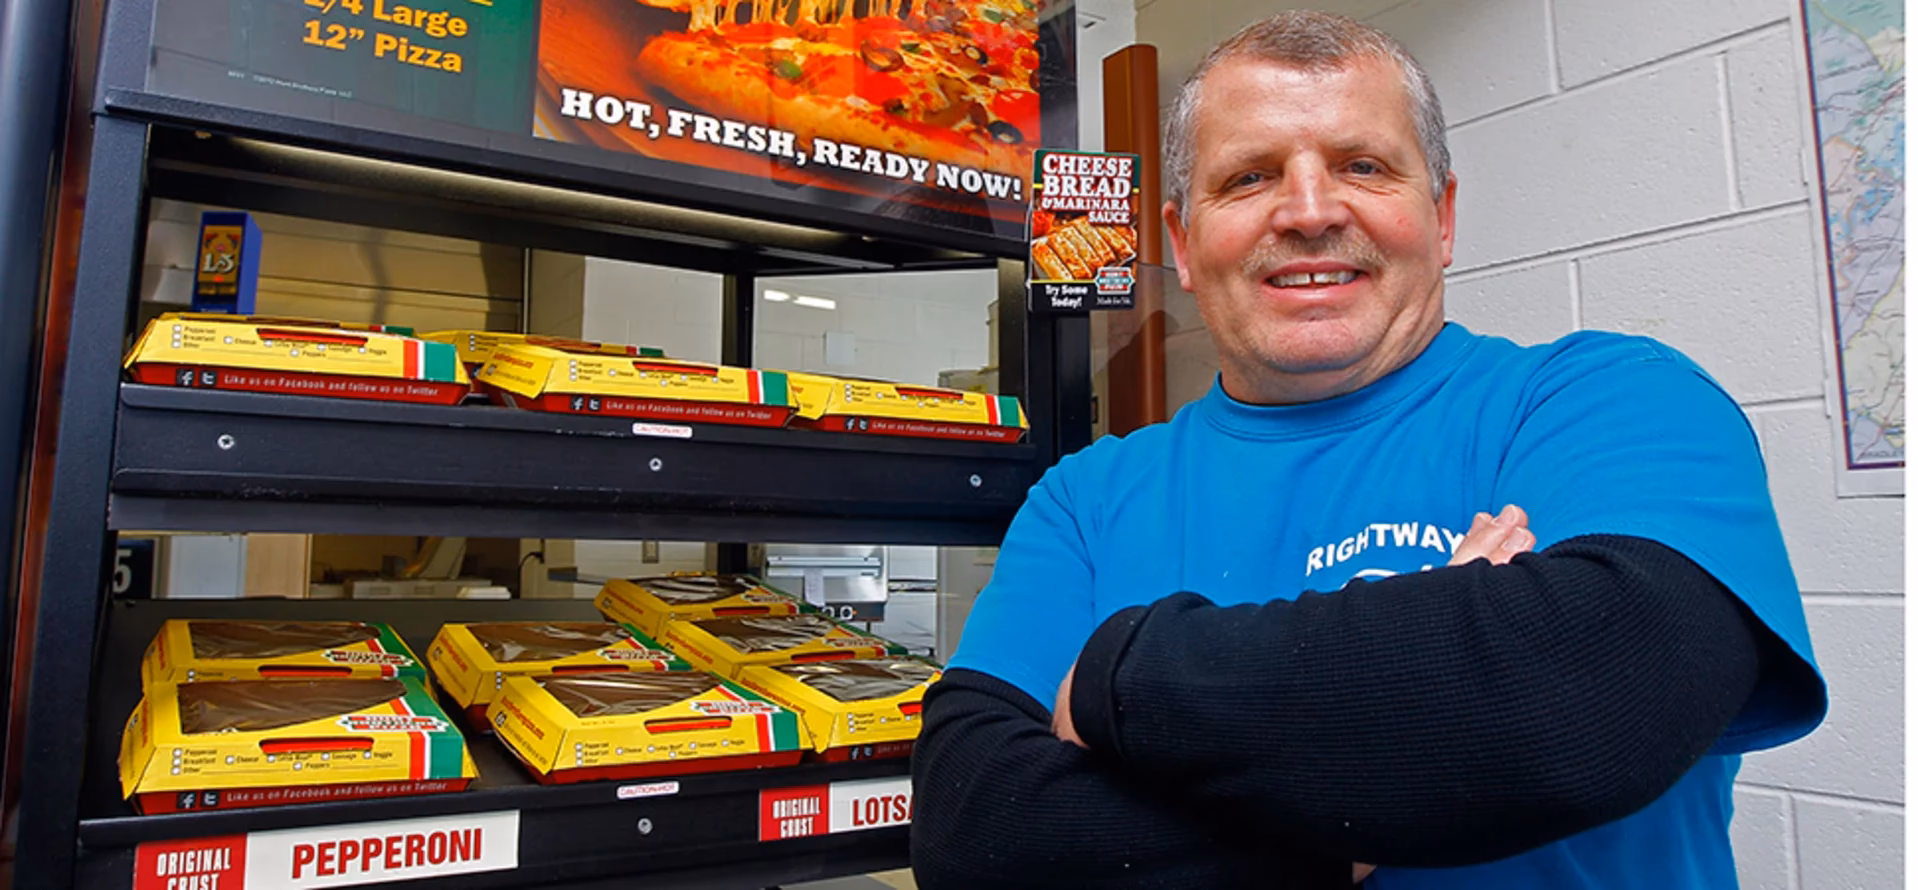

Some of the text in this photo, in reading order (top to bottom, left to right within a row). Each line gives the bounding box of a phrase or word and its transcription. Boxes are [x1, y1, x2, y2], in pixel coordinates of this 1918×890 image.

[373, 0, 468, 37] Large
[374, 33, 462, 72] Pizza
[561, 88, 1022, 201] HOT, FRESH, READY NOW!
[1043, 154, 1132, 177] CHEESE
[1043, 175, 1131, 198] BREAD
[1088, 211, 1130, 223] SAUCE
[1045, 285, 1088, 298] Try Some
[1051, 296, 1082, 308] Today!
[224, 374, 246, 384] Like
[279, 377, 325, 389] Facebook
[348, 382, 377, 392] follow
[408, 385, 439, 396] Twitter
[606, 401, 622, 410] Like
[648, 403, 685, 414] Facebook
[701, 406, 723, 417] follow
[747, 409, 772, 421] Twitter
[1306, 522, 1464, 576] RIGHTWAY
[112, 549, 132, 594] 5
[227, 793, 248, 802] Like
[283, 786, 331, 799] Facebook
[355, 784, 384, 794] follow
[414, 781, 447, 791] Twitter
[773, 797, 820, 819] ORIGINAL
[853, 793, 913, 826] LOTS
[780, 817, 814, 838] CRUST
[157, 847, 231, 877] ORIGINAL
[292, 828, 482, 879] PEPPERONI
